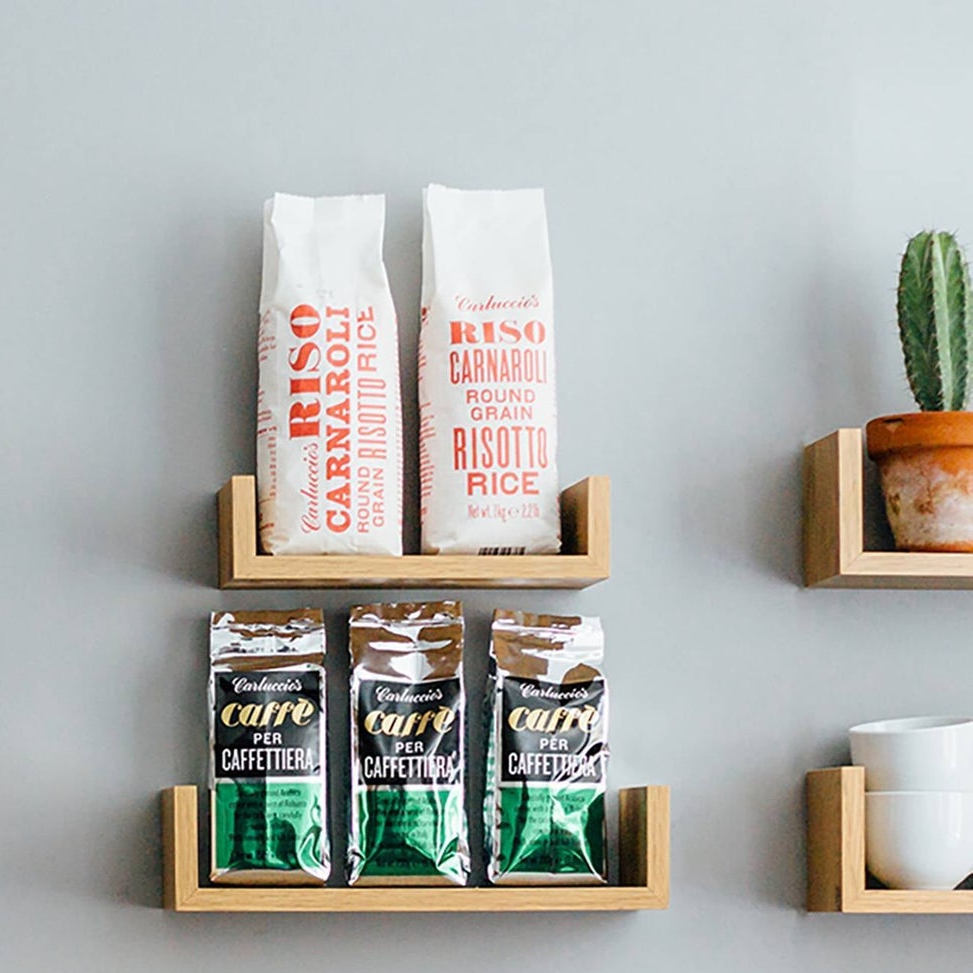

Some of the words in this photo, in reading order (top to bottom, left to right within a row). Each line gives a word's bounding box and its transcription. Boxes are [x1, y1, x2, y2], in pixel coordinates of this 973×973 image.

[454, 294, 540, 312] Carluccio's
[356, 305, 378, 373] RICE
[448, 319, 546, 345] RISO
[288, 303, 322, 439] RISO
[449, 350, 548, 385] CARNAROLI
[466, 388, 536, 404] ROUND
[325, 306, 352, 534] CARNAROLI
[357, 377, 387, 460] RISOTTO
[470, 405, 533, 422] GRAIN
[453, 425, 548, 471] RISOTTO
[300, 442, 320, 534] Carluccio's
[467, 472, 540, 496] RICE
[357, 466, 371, 533] ROUND
[371, 468, 385, 528] GRAIN
[231, 676, 303, 693] Carluccio's
[375, 685, 443, 703] Carluccio's
[519, 682, 589, 700] Carluccio's
[221, 697, 315, 728] caffè
[364, 705, 456, 737] caffè
[508, 704, 599, 733] caffè
[253, 732, 282, 745] PER
[395, 741, 424, 753] PER
[539, 738, 568, 750] PER
[222, 748, 314, 771] CAFFETTIERA
[364, 755, 453, 778] CAFFETTIERA
